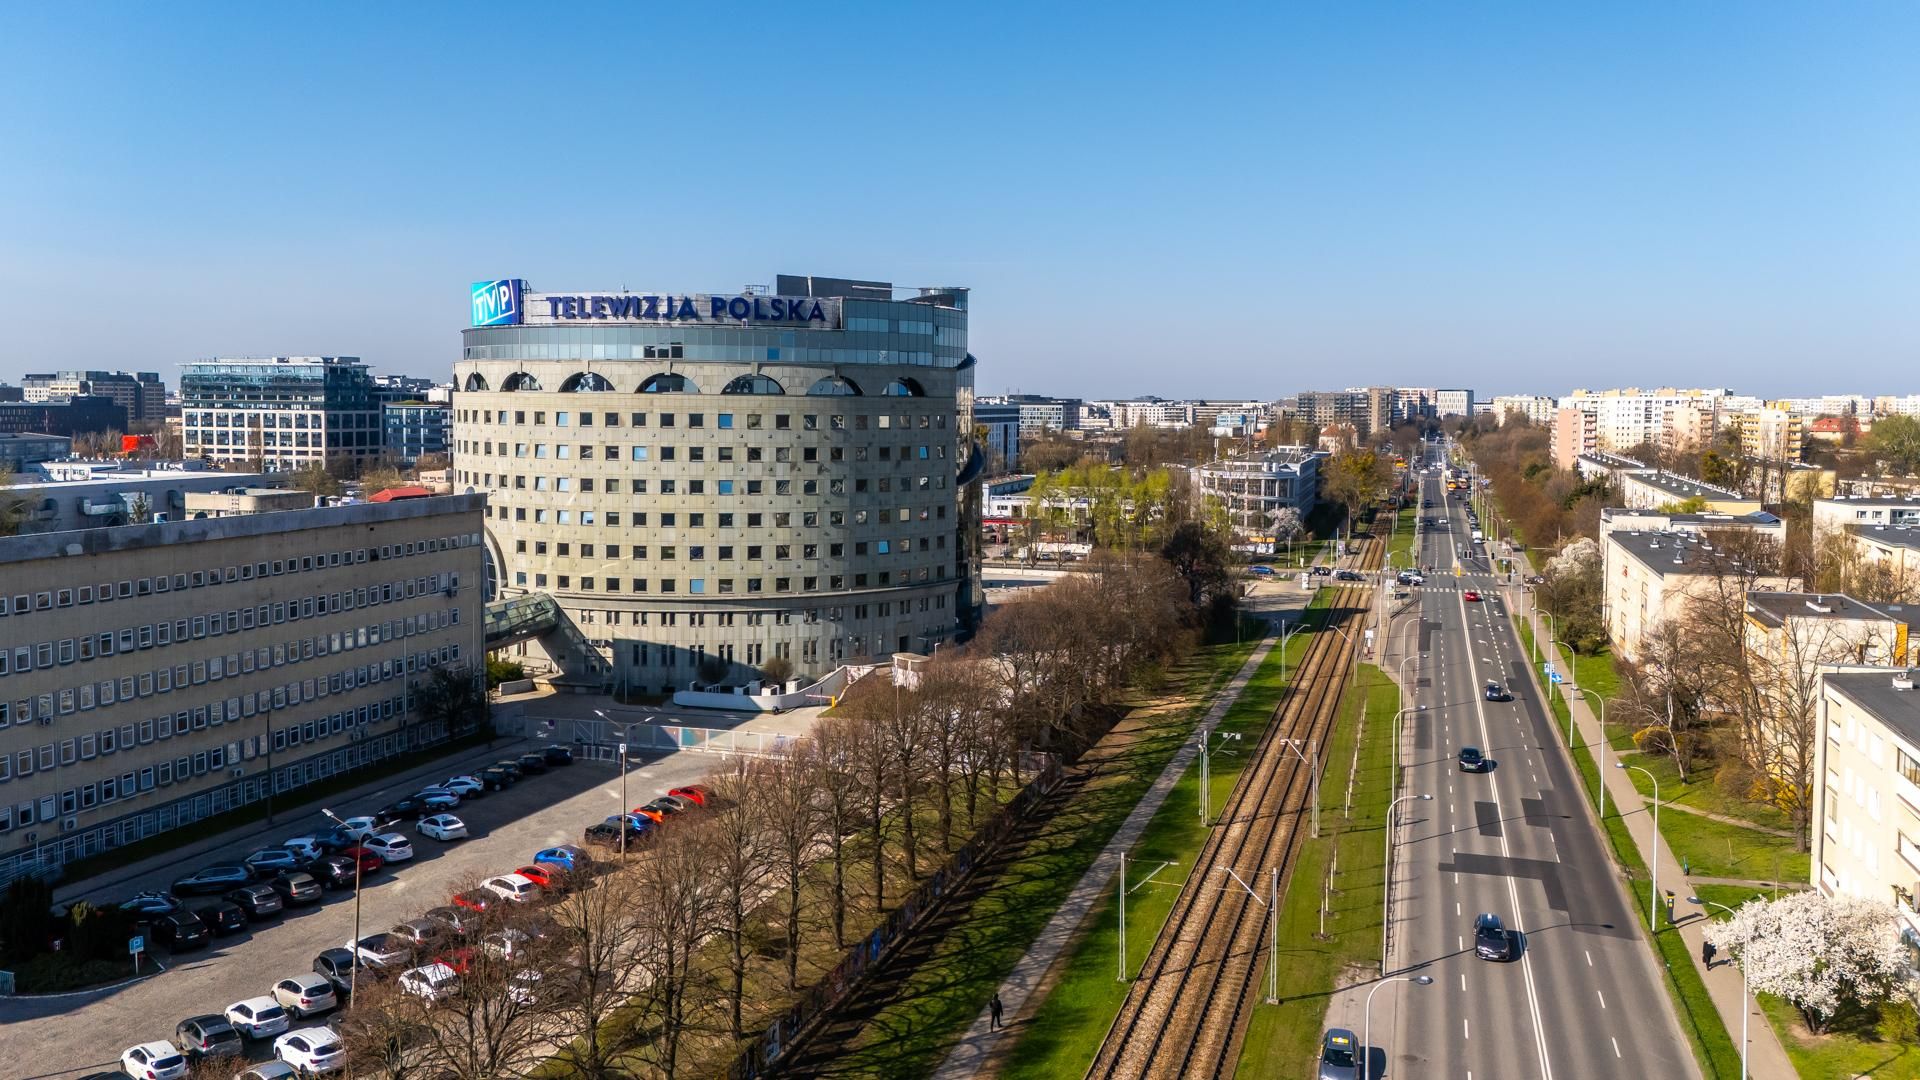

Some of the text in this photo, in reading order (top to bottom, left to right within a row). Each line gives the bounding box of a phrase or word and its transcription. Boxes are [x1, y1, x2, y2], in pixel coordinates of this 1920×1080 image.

[474, 284, 511, 321] TVP
[546, 296, 826, 321] TELEWIZJA POLSKA
